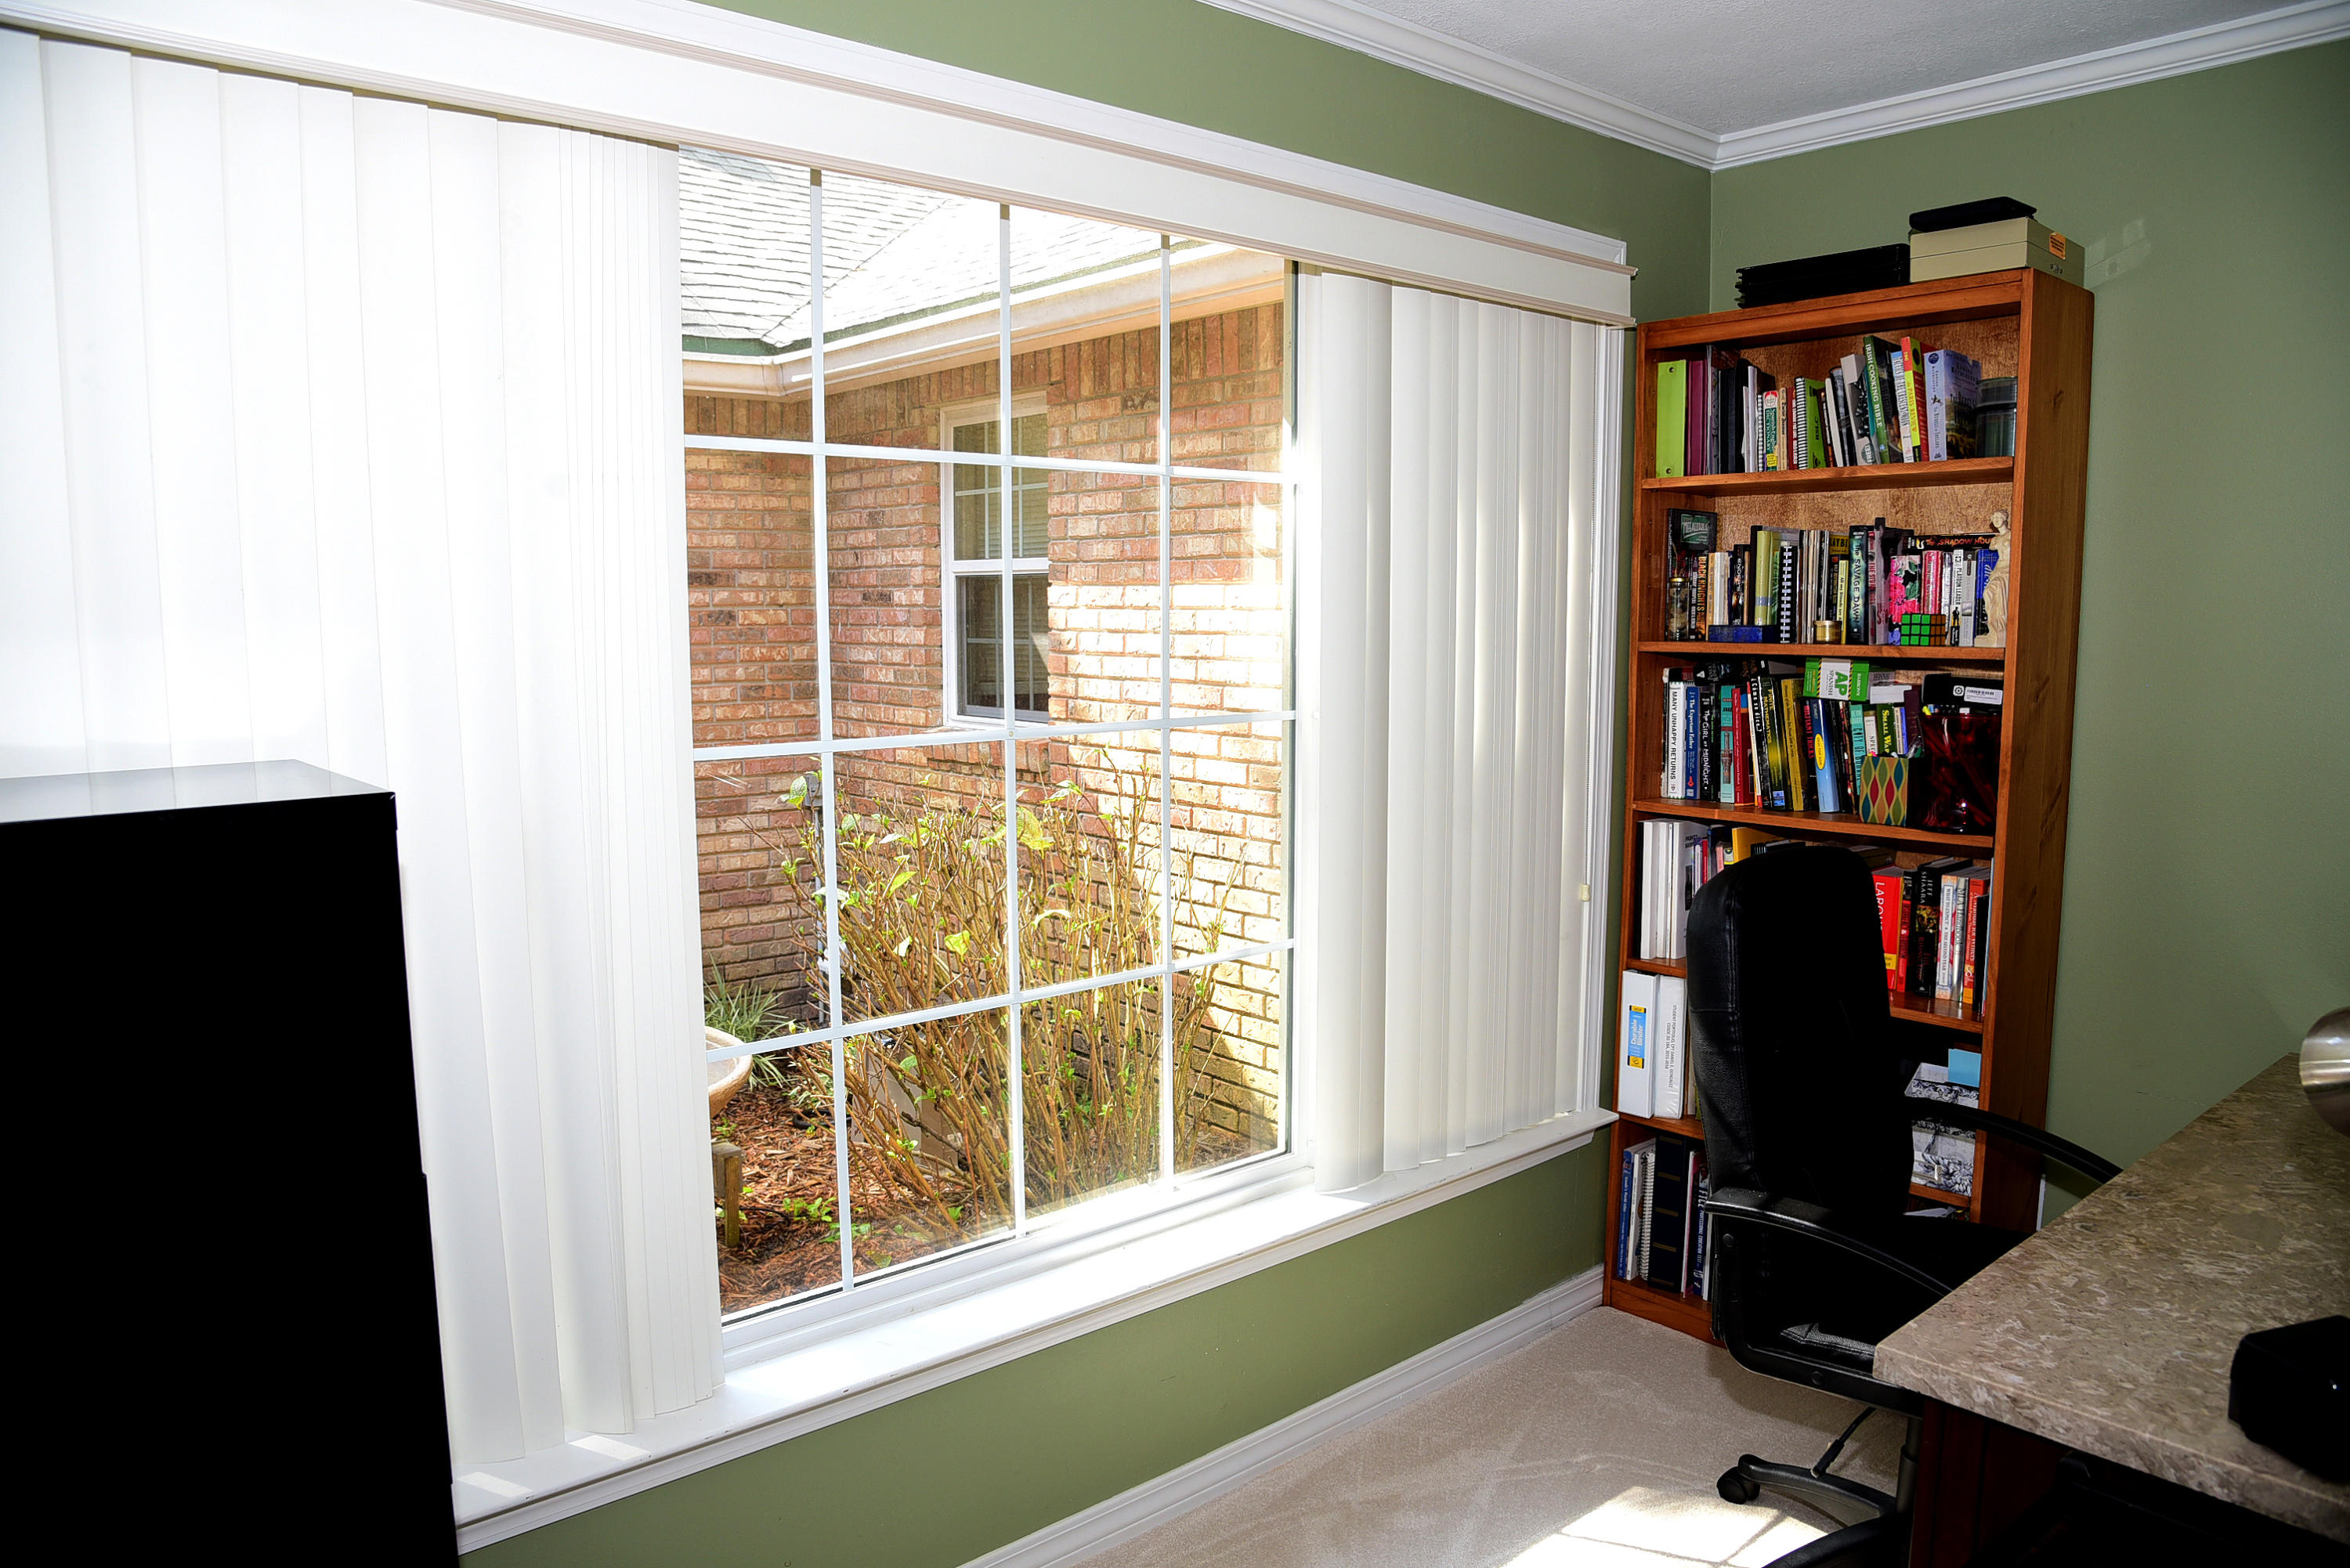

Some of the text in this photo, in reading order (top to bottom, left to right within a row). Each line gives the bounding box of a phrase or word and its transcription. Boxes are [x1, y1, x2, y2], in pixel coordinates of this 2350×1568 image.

[1868, 364, 1879, 401] COOKING
[1874, 403, 1883, 428] BIBLE
[1937, 538, 1972, 547] SHADOW
[1974, 537, 1993, 545] HOU
[1698, 556, 1707, 578] BLACK
[1697, 579, 1706, 612] KNIGHTS
[1852, 596, 1860, 623] DAWN
[1835, 671, 1849, 695] AP
[1701, 722, 1710, 740] GIRL
[1764, 696, 1773, 744] MATHEMATICS
[1804, 705, 1813, 735] MILITANT
[1882, 710, 1890, 735] SMALL
[1853, 728, 1864, 742] CITY
[1855, 745, 1864, 755] OF
[1701, 749, 1711, 786] MIDNIGHT
[1955, 907, 1965, 946] Handbook
